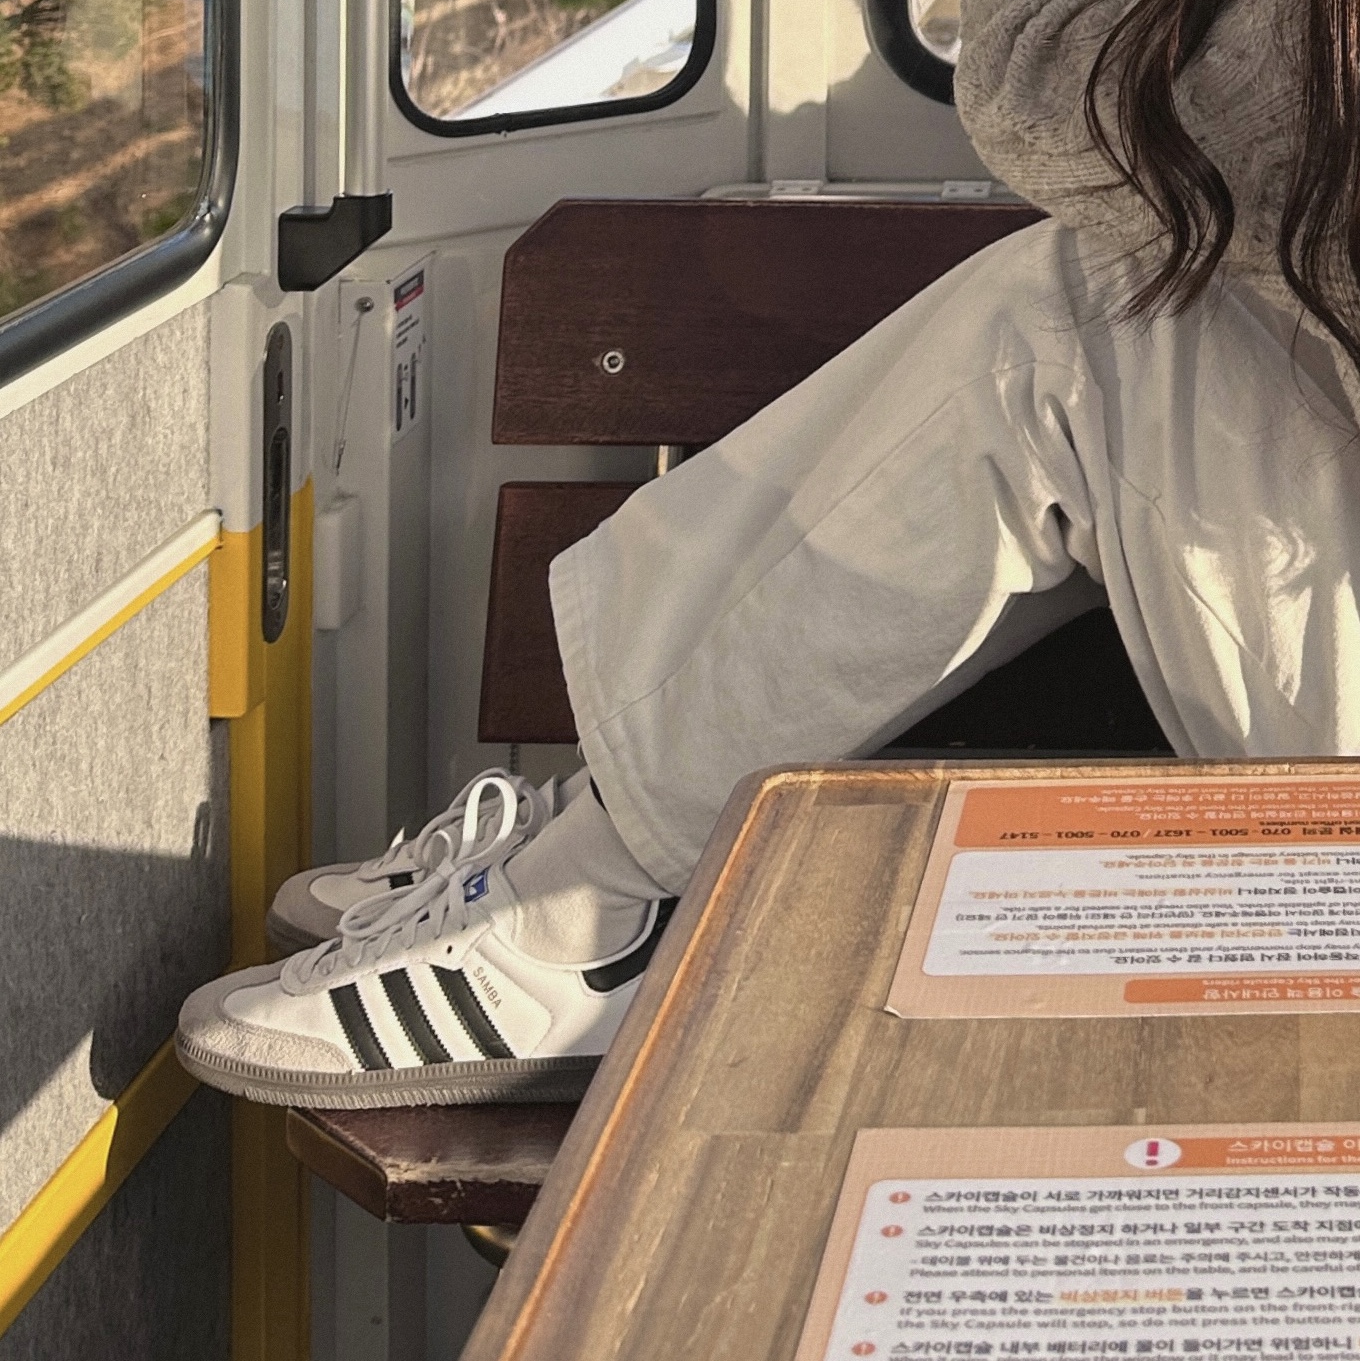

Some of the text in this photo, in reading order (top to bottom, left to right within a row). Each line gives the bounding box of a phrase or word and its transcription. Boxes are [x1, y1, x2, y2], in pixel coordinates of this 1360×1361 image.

[1302, 828, 1332, 836] 문의
[473, 966, 502, 1010] SAMBA
[1204, 989, 1280, 999] 안내사항
[1287, 988, 1344, 998] 이용객
[1229, 1139, 1334, 1151] 스카이캡슐
[925, 1191, 1038, 1202] 스카이캡슐이
[1044, 1191, 1080, 1201] 서로
[1086, 1189, 1180, 1200] 가까워지면
[1186, 1187, 1317, 1198] 거리감지센서가
[917, 1224, 1032, 1236] 스카이캡슐은
[1038, 1224, 1114, 1236] 비상정지
[1120, 1223, 1178, 1234] 하거나
[1183, 1222, 1221, 1233] 일부
[1228, 1221, 1266, 1233] 구간
[1272, 1220, 1310, 1231] 도착
[904, 1291, 942, 1303] 전면
[950, 1290, 1008, 1302] 우측에
[1014, 1290, 1054, 1303] 있는
[1059, 1289, 1138, 1303] 비상정지
[1144, 1288, 1204, 1301] 버튼을
[1210, 1287, 1270, 1299] 누르면
[899, 1307, 913, 1315] If
[914, 1308, 947, 1317] you
[950, 1308, 997, 1317] press
[1000, 1307, 1029, 1316] the
[1032, 1307, 1126, 1316] emergency
[1130, 1306, 1167, 1315] stop
[1171, 1305, 1229, 1313] button
[1232, 1304, 1256, 1313] on
[1259, 1303, 1289, 1312] the
[896, 1320, 925, 1329] the
[930, 1319, 960, 1330] Sky
[963, 1320, 1032, 1329] Capsule
[1036, 1319, 1068, 1328] will
[1117, 1319, 1138, 1327] so
[1140, 1318, 1164, 1327] do
[1168, 1318, 1197, 1326] not
[1200, 1318, 1248, 1327] press
[1251, 1317, 1280, 1325] the
[1284, 1316, 1343, 1324] button
[890, 1341, 993, 1354] 스카이캡슐
[1000, 1341, 1040, 1353] 내부
[1046, 1341, 1128, 1353] 배터리에
[1135, 1339, 1174, 1353] 물이
[1182, 1338, 1263, 1351] 들어가면
[1270, 1337, 1352, 1350] 위험하니
